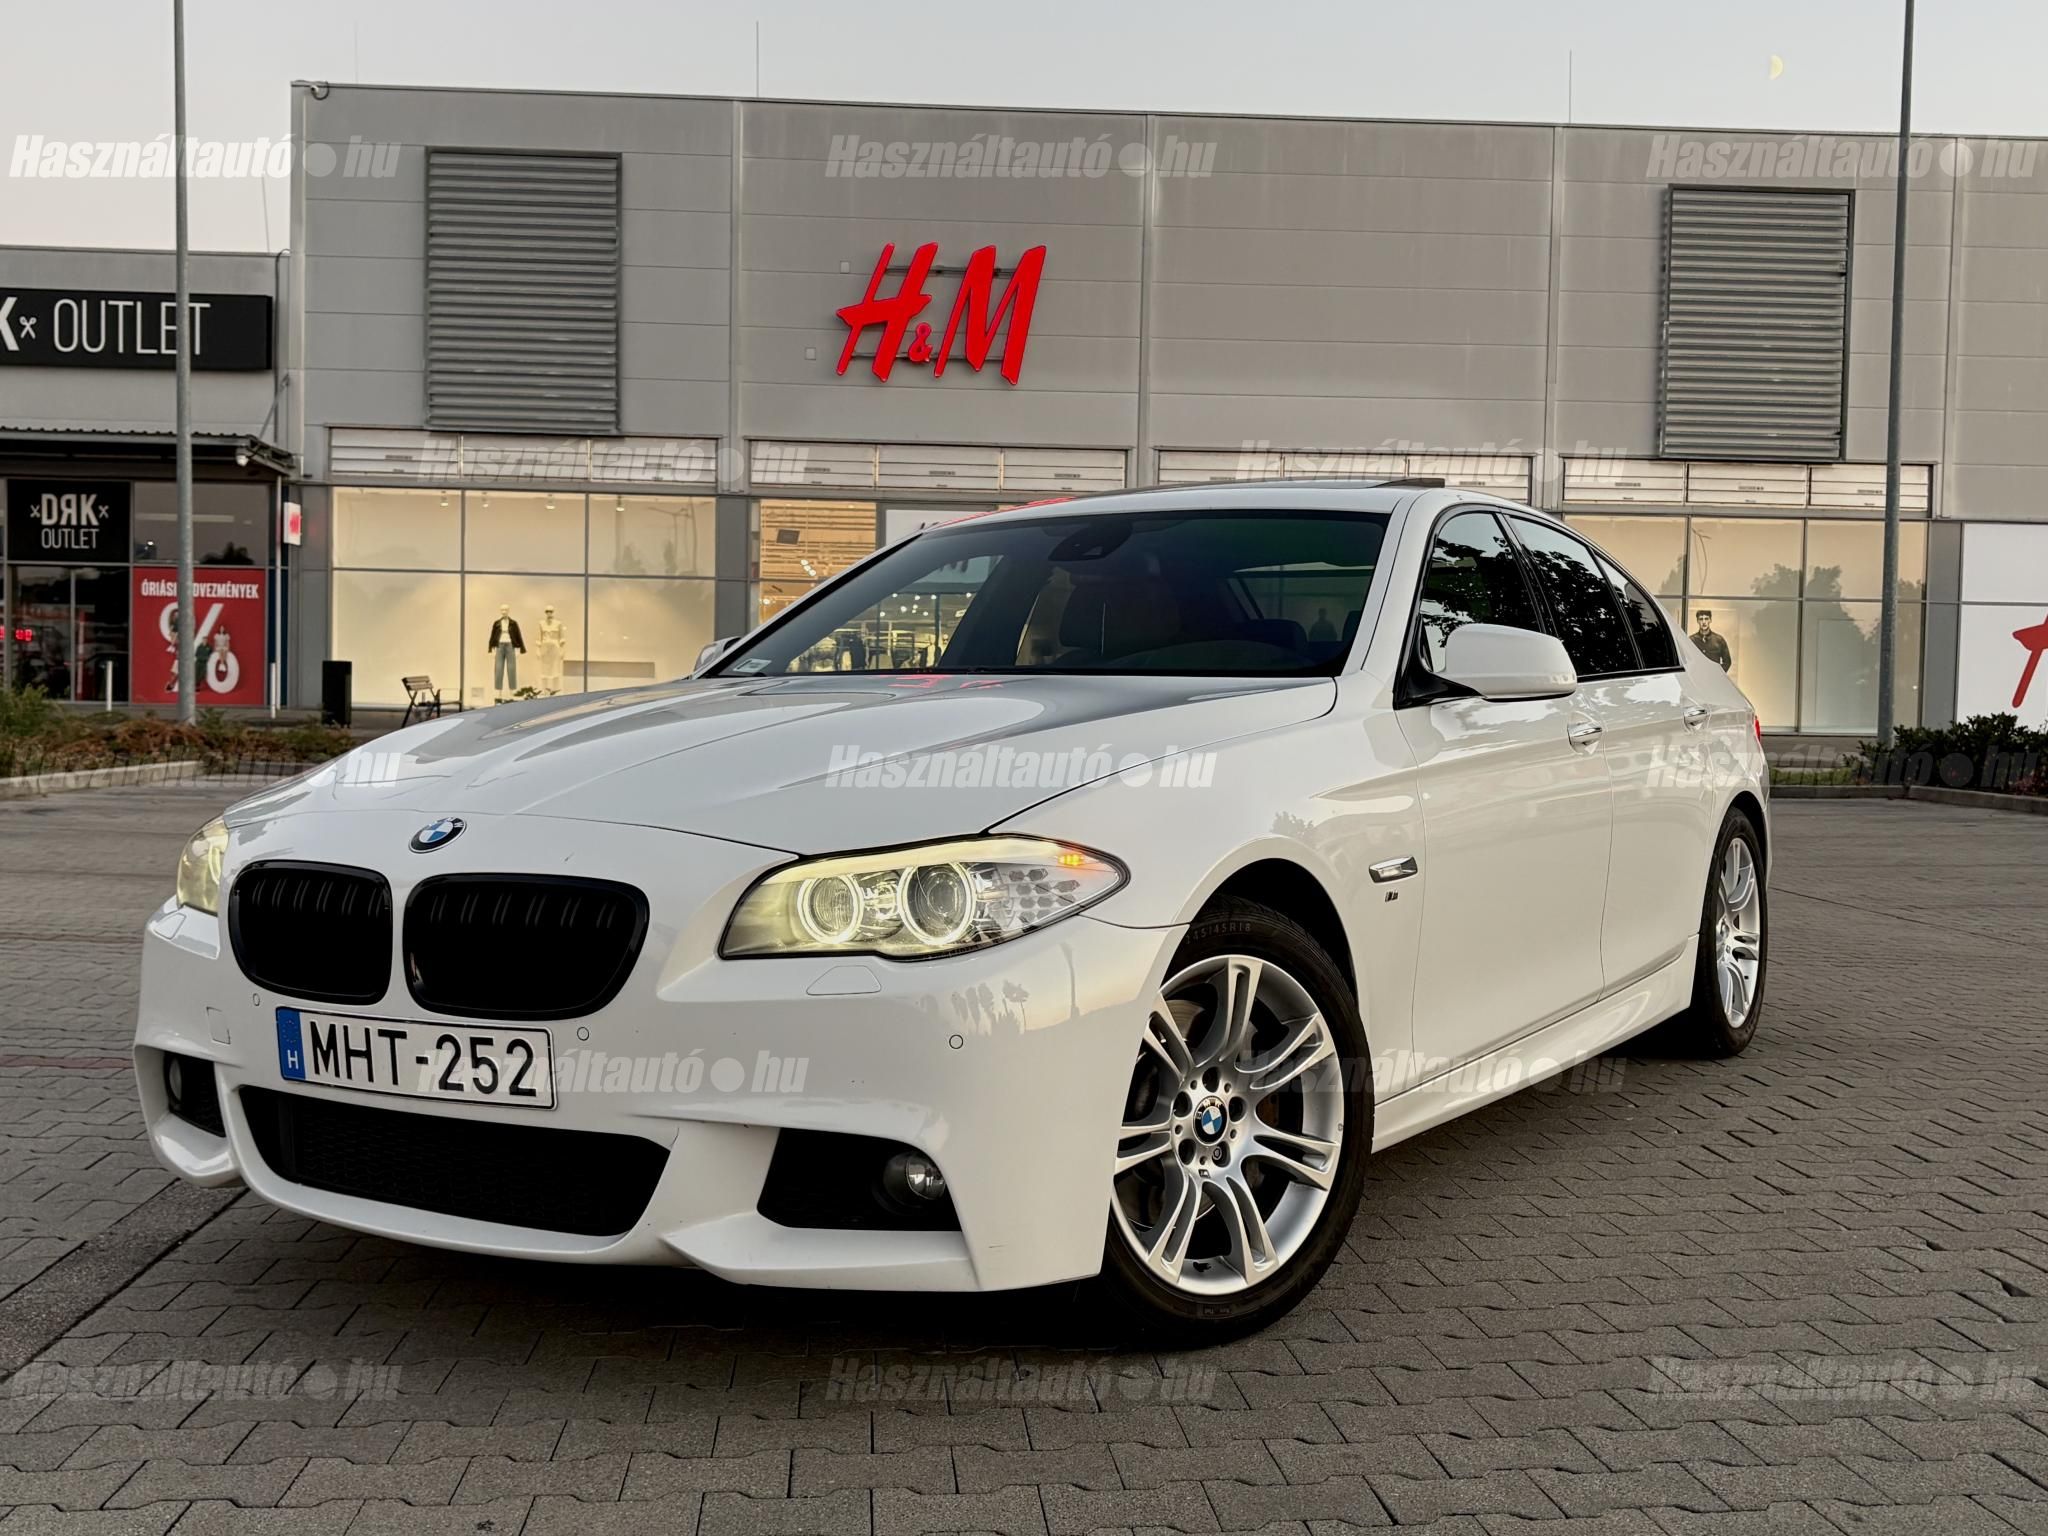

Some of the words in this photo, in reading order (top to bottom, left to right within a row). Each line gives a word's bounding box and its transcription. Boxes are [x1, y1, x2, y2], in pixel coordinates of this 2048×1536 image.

[53, 298, 211, 356] OUTLET
[836, 242, 1047, 386] H&M
[41, 528, 99, 549] OUTLET
[192, 583, 259, 599] DVEZMÉNYEK
[287, 1049, 300, 1071] H
[310, 1020, 537, 1097] MHT-252
